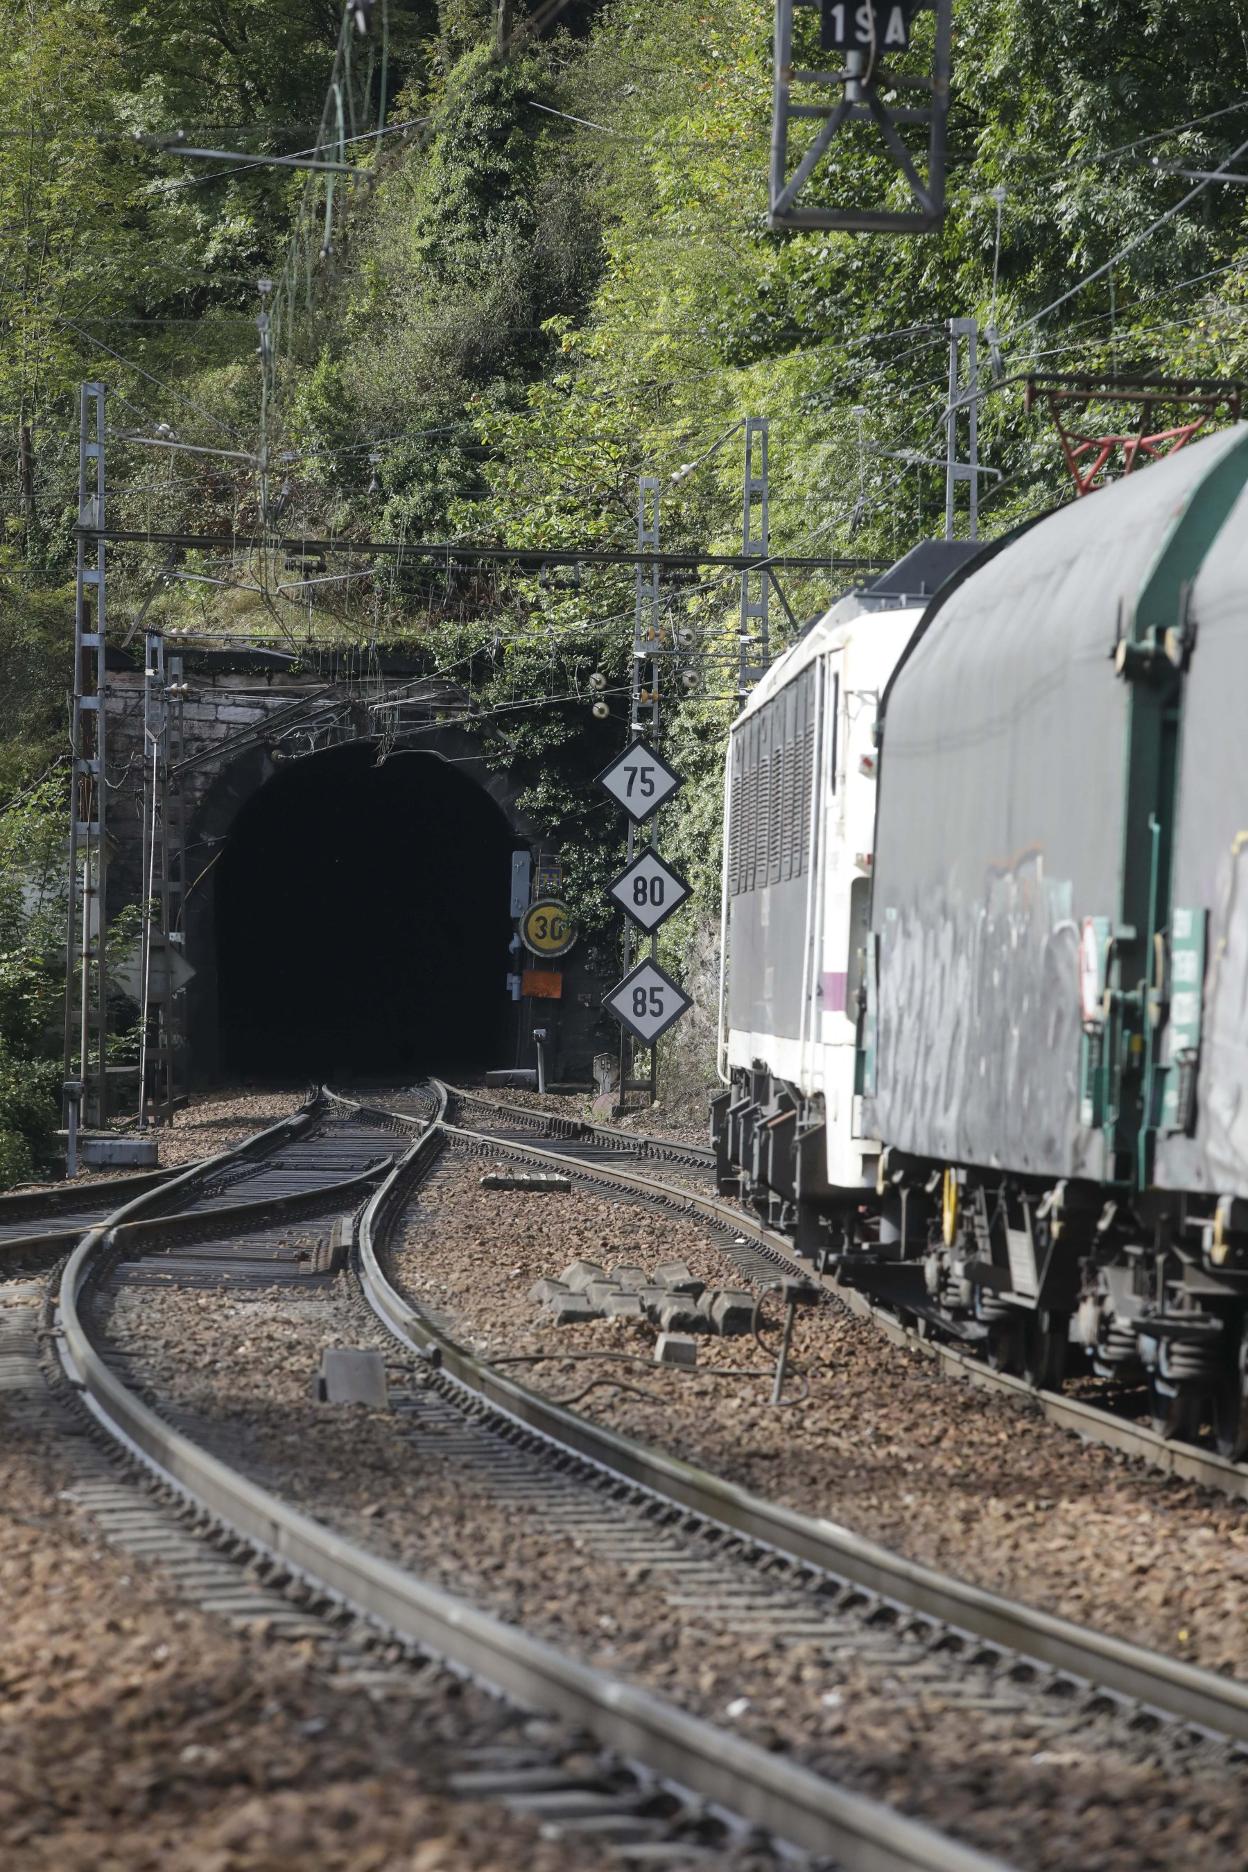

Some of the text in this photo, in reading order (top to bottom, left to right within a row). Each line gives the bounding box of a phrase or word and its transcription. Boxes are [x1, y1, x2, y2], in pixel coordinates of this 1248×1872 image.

[624, 767, 655, 798] 75
[633, 876, 665, 907] 80
[535, 915, 564, 941] 30
[632, 986, 665, 1018] 85
